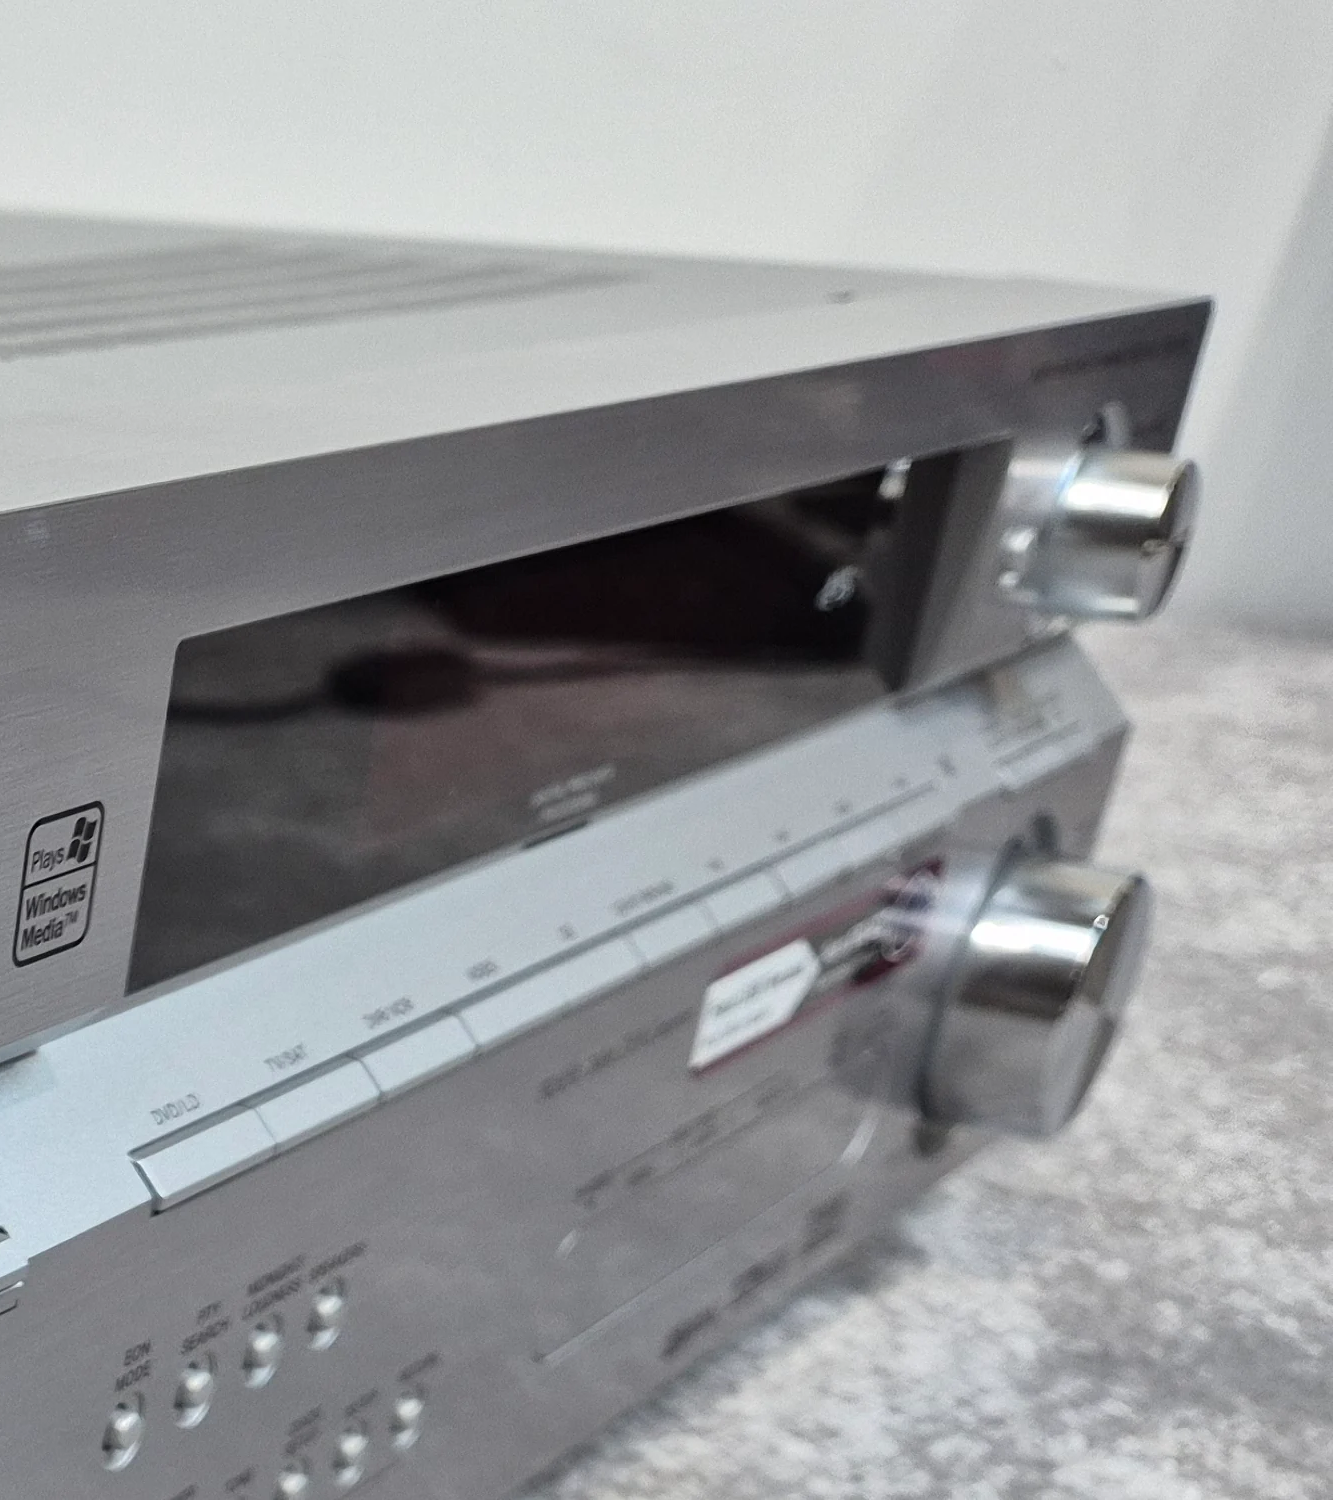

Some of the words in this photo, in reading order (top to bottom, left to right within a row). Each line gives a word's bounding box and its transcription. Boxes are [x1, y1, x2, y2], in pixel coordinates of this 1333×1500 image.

[31, 847, 65, 872] Plays
[25, 884, 86, 921] Windows
[150, 1093, 201, 1126] DVD/LD
